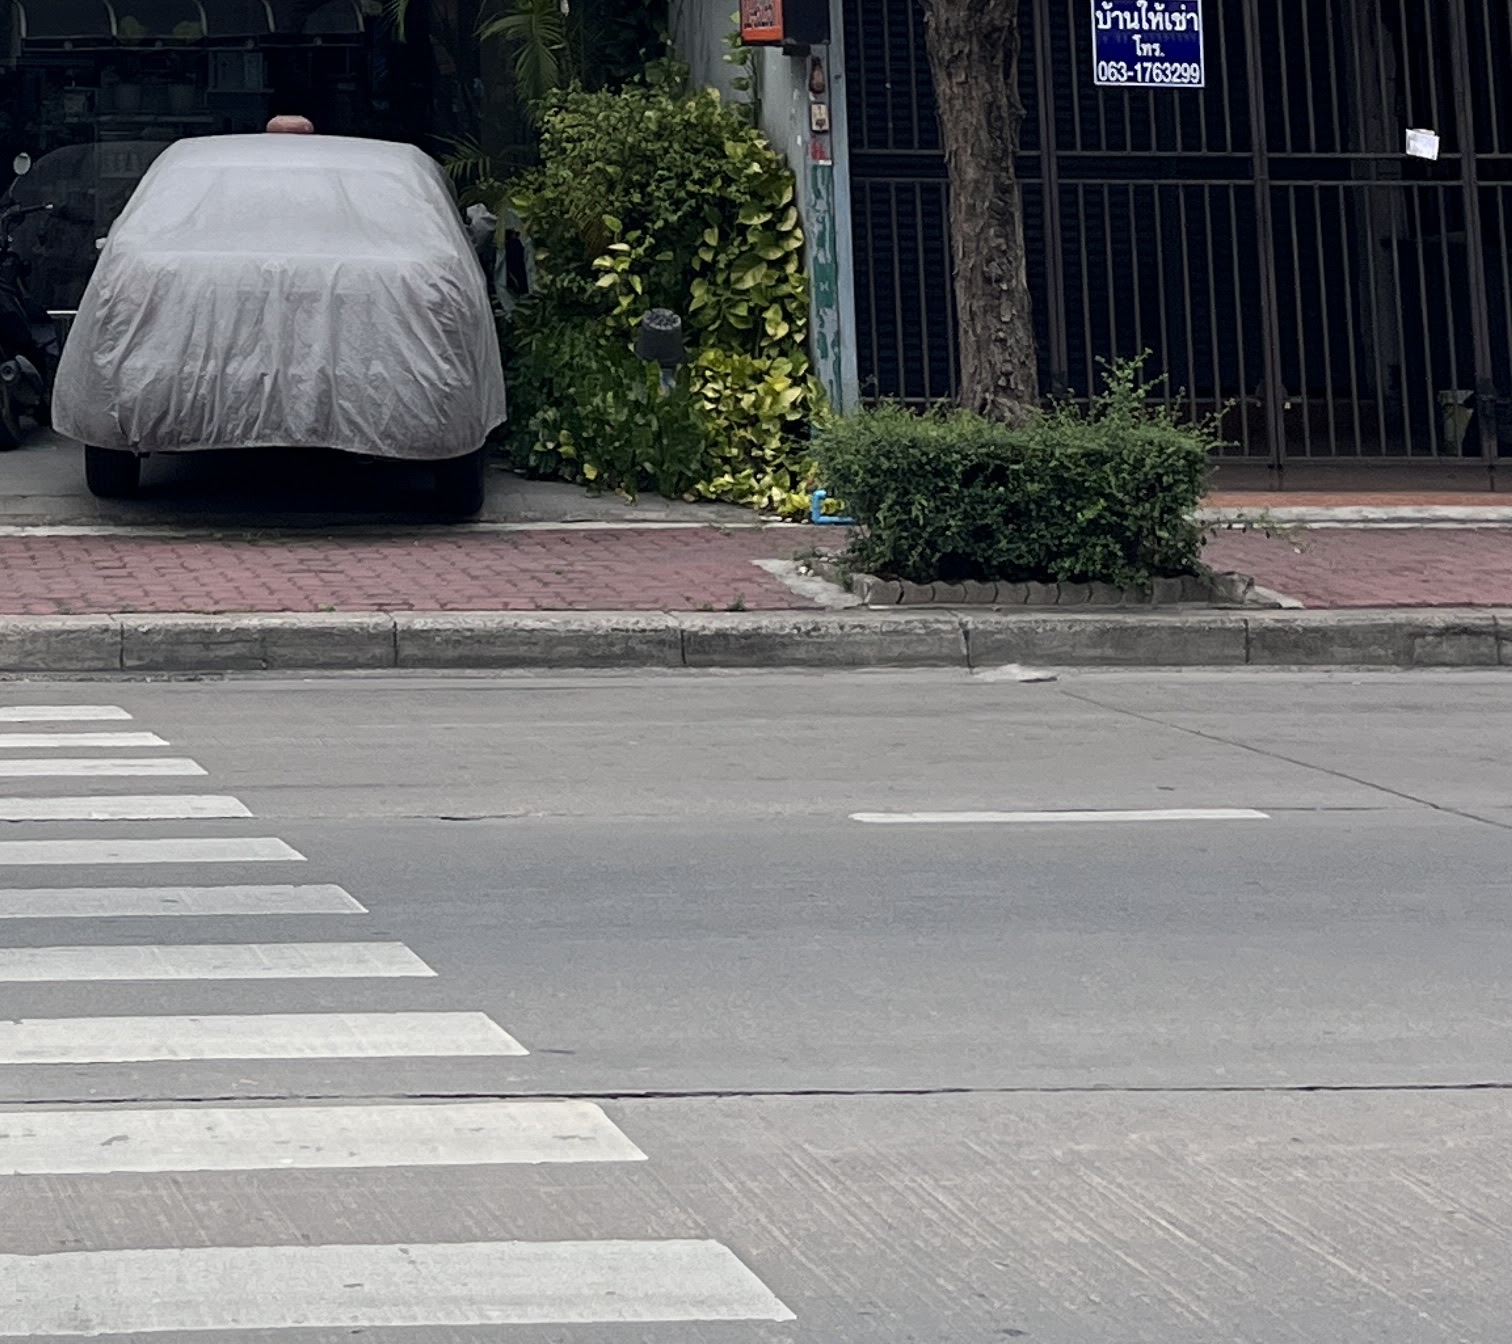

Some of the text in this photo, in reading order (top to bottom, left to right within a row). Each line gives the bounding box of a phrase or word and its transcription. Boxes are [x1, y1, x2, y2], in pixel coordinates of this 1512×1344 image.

[1095, 0, 1199, 31] บ้านให้เช่า
[1131, 33, 1166, 57] โทร.
[1097, 60, 1201, 83] 063-1763299
